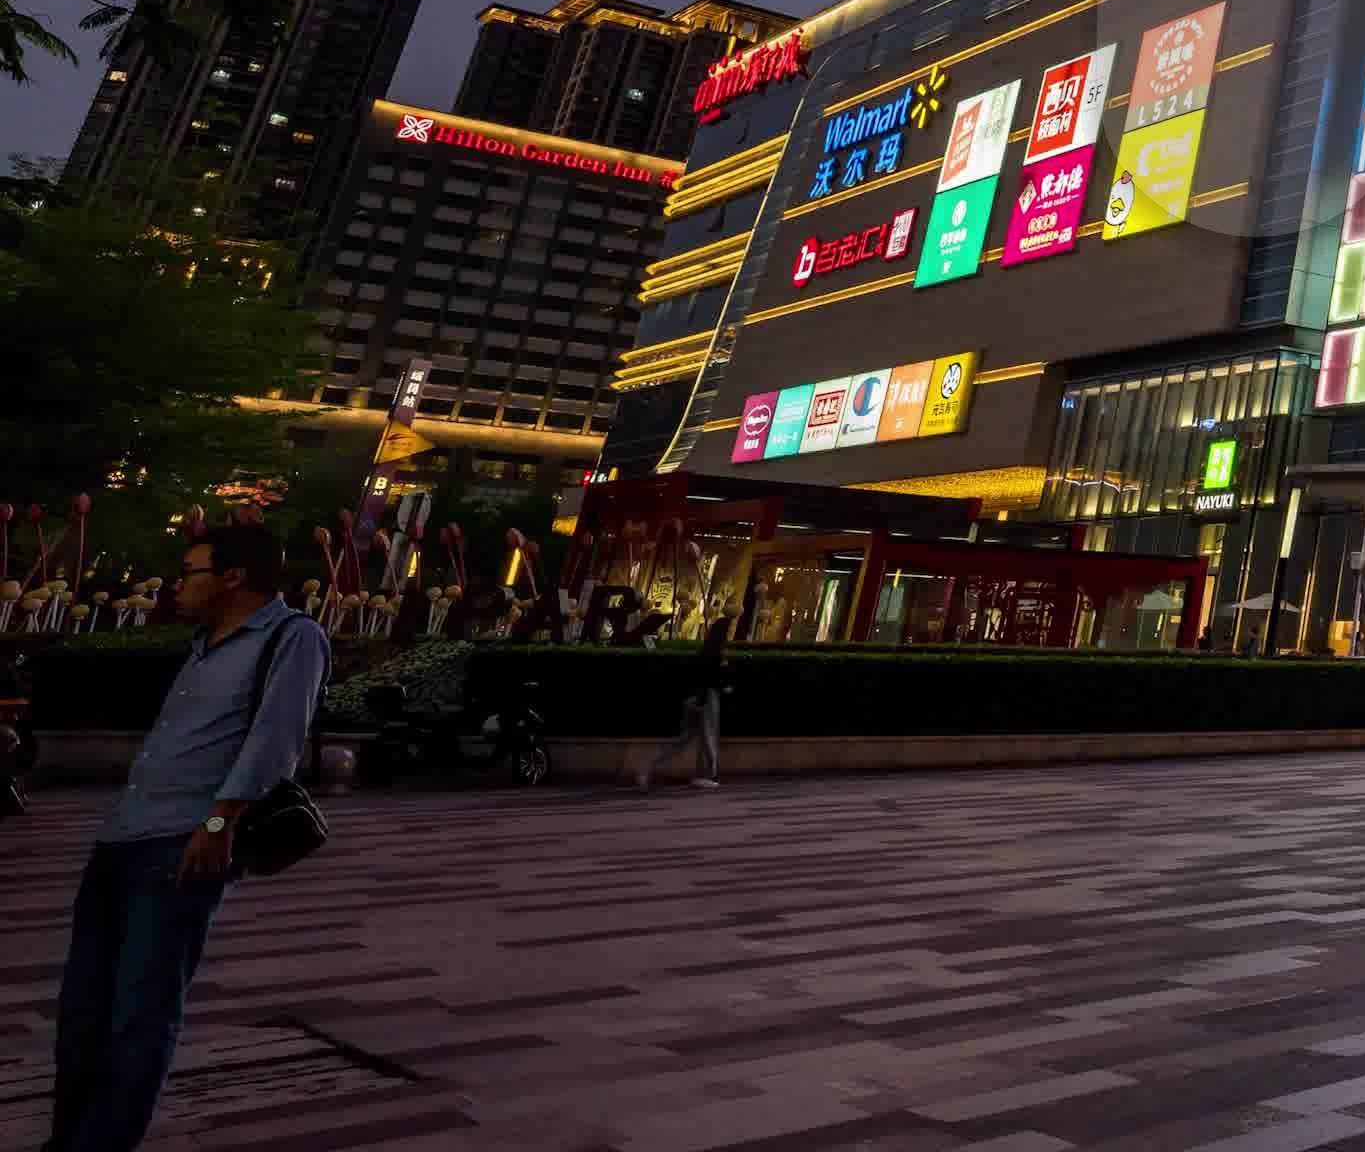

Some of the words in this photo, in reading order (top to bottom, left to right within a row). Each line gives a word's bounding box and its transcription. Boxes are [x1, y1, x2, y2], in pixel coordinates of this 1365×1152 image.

[1041, 75, 1081, 116] 西贝
[1087, 84, 1103, 104] 5F
[824, 86, 912, 153] Walmart
[434, 126, 515, 157] Hilton
[521, 143, 607, 174] Garden
[611, 160, 652, 183] Inn
[809, 132, 904, 199] 沃尔玛
[374, 477, 388, 490] B
[1196, 494, 1234, 510] NAYUKI
